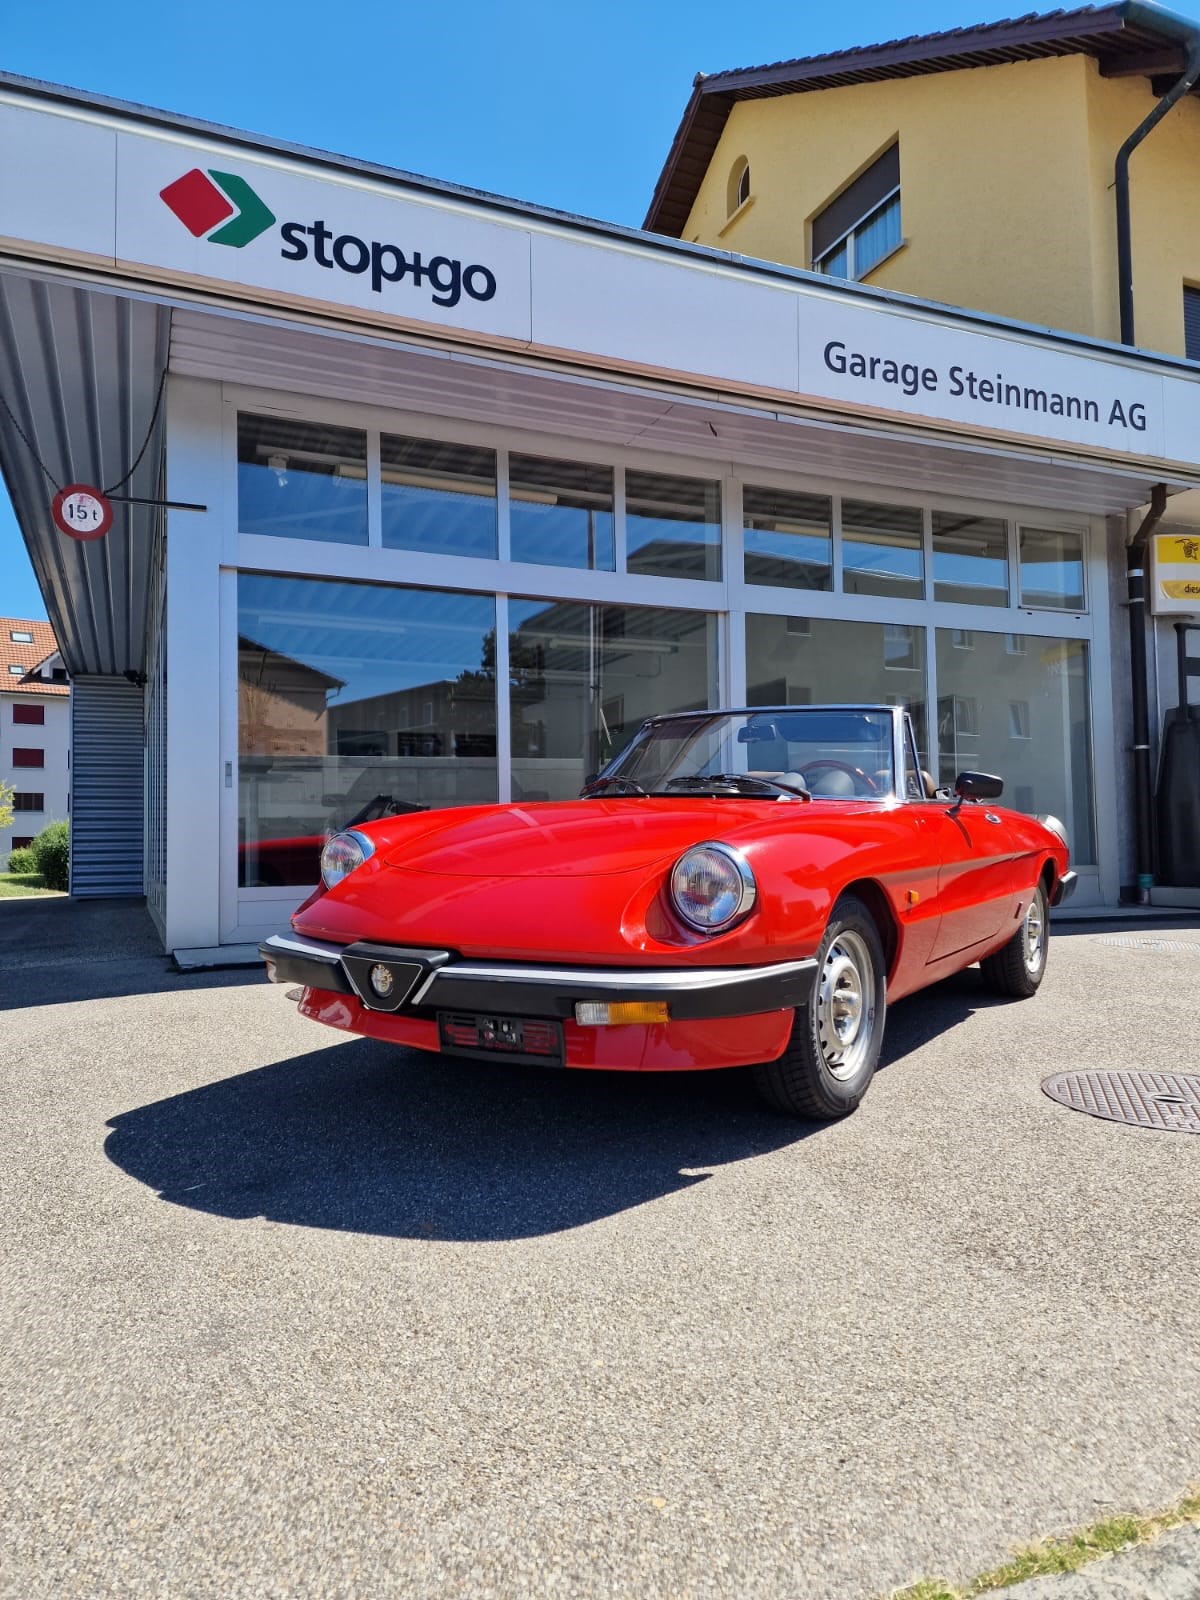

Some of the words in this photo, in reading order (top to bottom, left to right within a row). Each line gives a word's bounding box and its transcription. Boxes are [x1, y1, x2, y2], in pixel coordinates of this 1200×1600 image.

[281, 220, 496, 307] stop+go
[824, 342, 938, 395] Garage
[949, 366, 1098, 422] Steinmann
[1109, 399, 1146, 431] AG
[68, 504, 88, 520] 15
